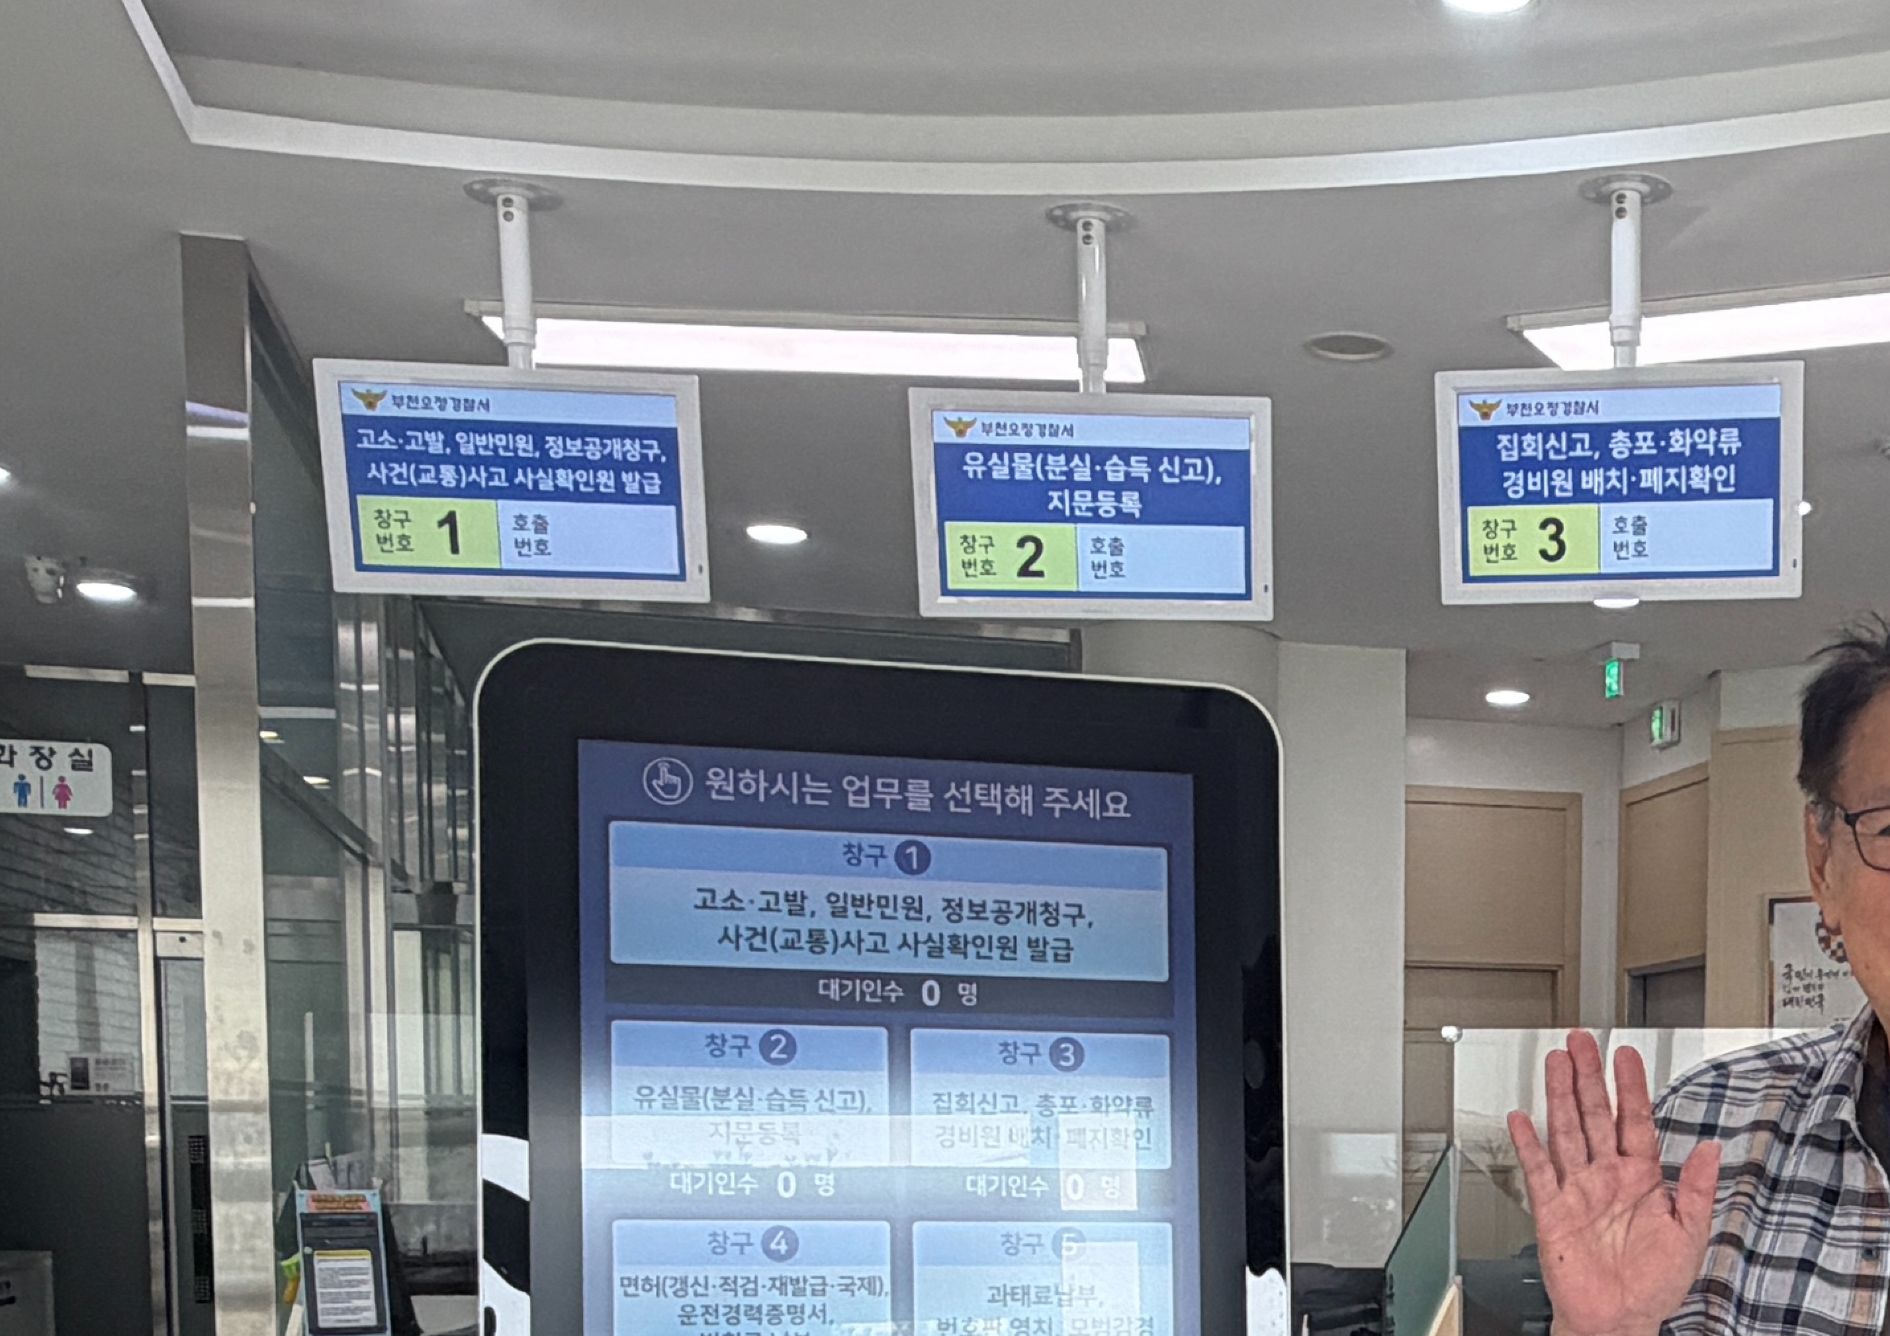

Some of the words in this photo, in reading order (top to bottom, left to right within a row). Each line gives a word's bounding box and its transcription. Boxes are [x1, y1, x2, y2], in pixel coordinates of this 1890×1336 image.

[356, 429, 451, 455] 고소·고발,
[456, 433, 539, 459] 일반민원,
[545, 437, 666, 463] 정보공개청구,
[1497, 431, 1600, 462] 집회신고,
[1608, 428, 1741, 456] 총포·화약류
[367, 463, 509, 488] 사건(교통)사고
[514, 467, 615, 493] 사실확인원
[622, 472, 661, 495] 발급
[963, 452, 1151, 482] 유실물(분실·습득
[1159, 458, 1221, 485] 신고),
[1503, 469, 1573, 498] 경비원
[1581, 464, 1736, 495] 배치·폐지확인
[1048, 490, 1142, 518] 지문등록
[375, 510, 411, 529] 창구
[513, 514, 549, 533] 호출
[1482, 519, 1517, 539] 창구
[1612, 516, 1647, 534] 호출
[377, 534, 413, 553] 번호
[437, 510, 460, 555] 1
[960, 535, 995, 554] 창구
[1539, 517, 1566, 562] 3
[514, 538, 551, 557] 번호
[1016, 535, 1045, 578] 2
[1090, 537, 1125, 555] 호출
[1483, 542, 1518, 564] 번호
[1613, 541, 1648, 559] 번호
[962, 559, 996, 578] 번호
[1091, 561, 1125, 579] 번호
[706, 768, 832, 806] 원하시는
[842, 776, 933, 814] 업무를
[944, 781, 1033, 817] 선택해
[1043, 788, 1131, 820] 주세요
[842, 842, 887, 868] 창구
[693, 888, 816, 918] 고소·고발,
[825, 893, 932, 924] 일반민원,
[942, 900, 1093, 930] 정보공개청구,
[718, 925, 889, 956] 사건(교통)사고
[898, 930, 1018, 960] 사실확인원
[1027, 937, 1074, 964] 발급
[818, 979, 904, 1003] 대기인수
[921, 980, 940, 1007] 0
[957, 982, 978, 1006] 명
[705, 1035, 751, 1058] 창구
[998, 1042, 1040, 1064] 창구
[813, 1091, 872, 1114] 신고),
[933, 1093, 1028, 1117] 집회신고,
[935, 1126, 1000, 1148] 경비원
[670, 1172, 759, 1196] 대기인수
[777, 1173, 796, 1198] 0
[966, 1174, 1049, 1198] 대기인수
[1066, 1173, 1085, 1200] 0
[707, 1231, 753, 1256] 창구
[1000, 1232, 1044, 1257] 창구
[678, 1304, 834, 1326] 운전경력증명서,
